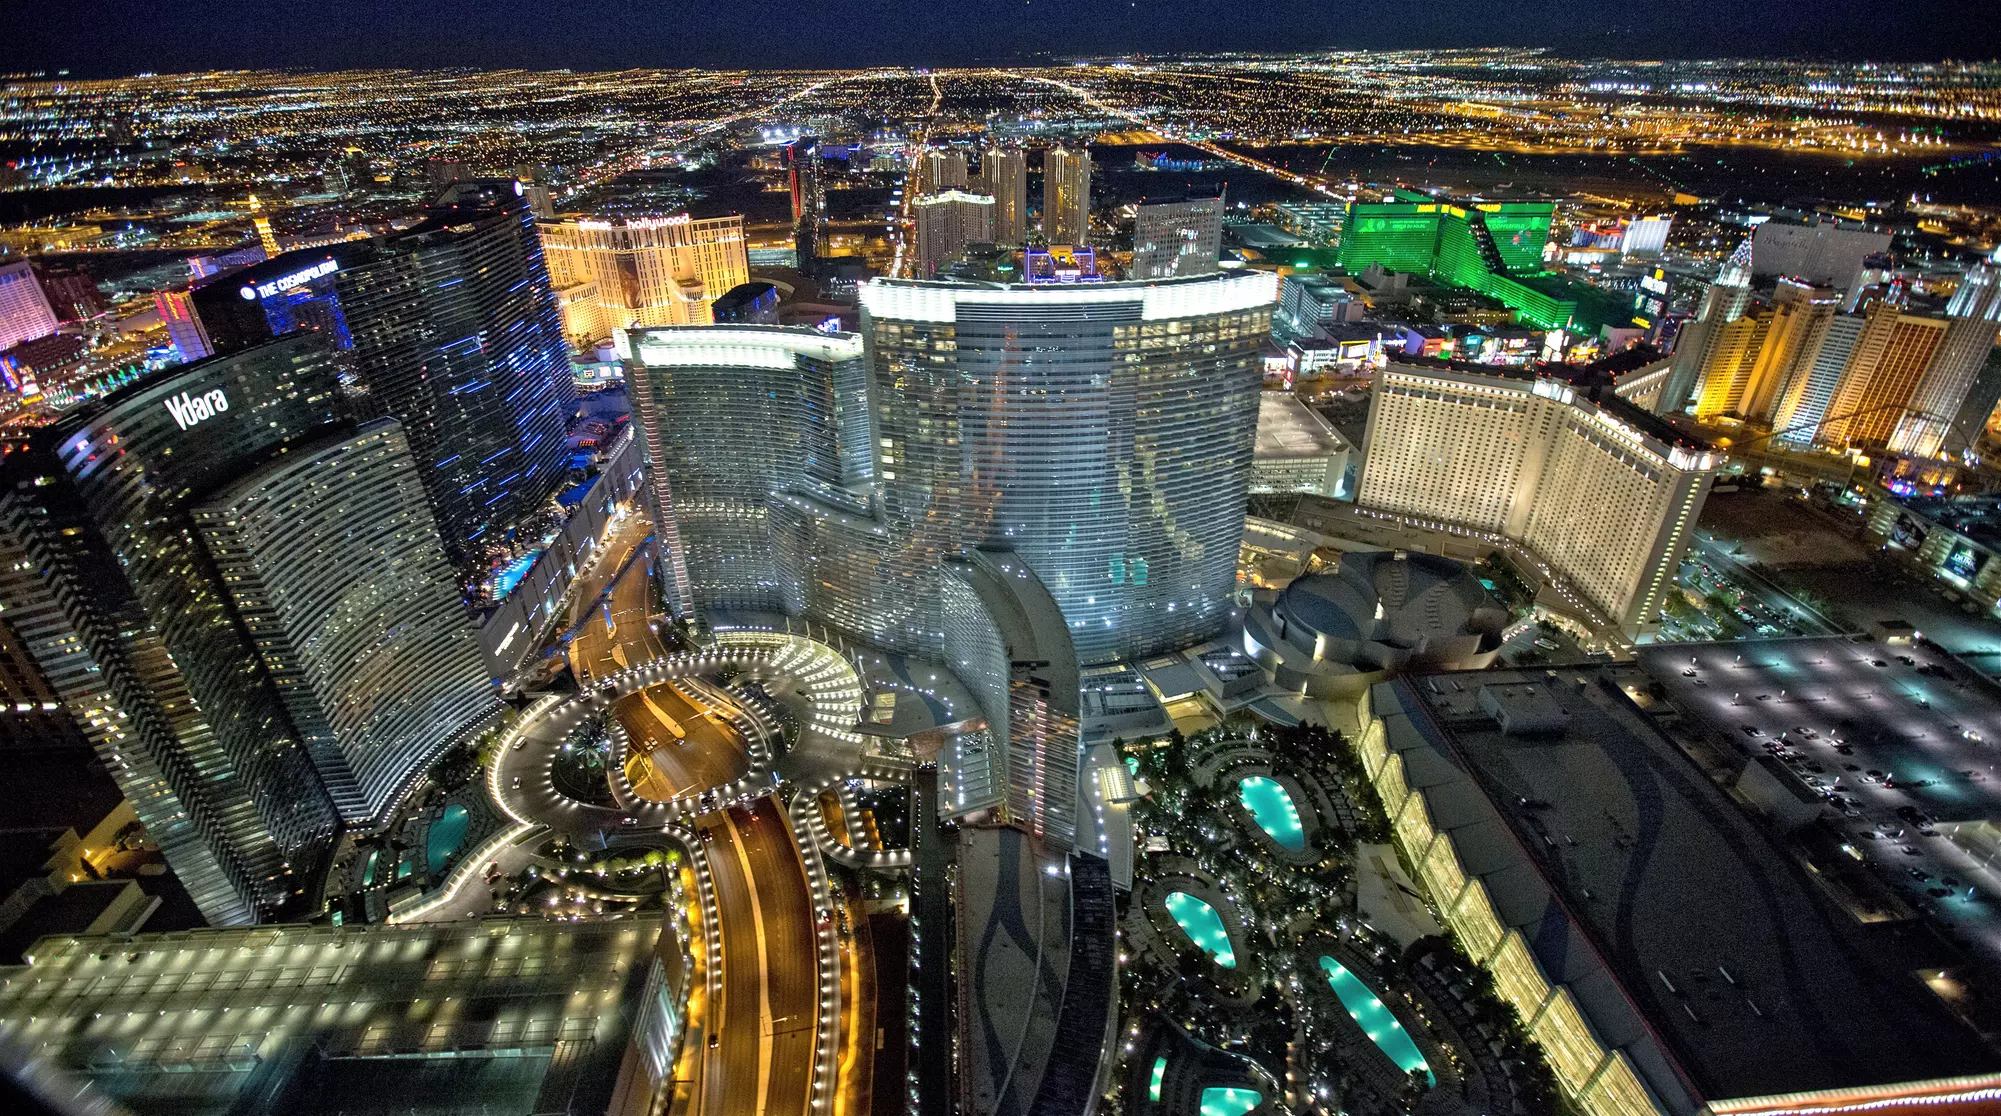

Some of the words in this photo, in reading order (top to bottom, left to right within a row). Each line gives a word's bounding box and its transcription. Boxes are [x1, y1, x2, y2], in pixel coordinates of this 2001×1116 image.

[625, 212, 690, 231] hollywood
[257, 282, 279, 298] THE
[276, 260, 339, 291] COSMOPOLITAN
[163, 389, 229, 431] Vdara
